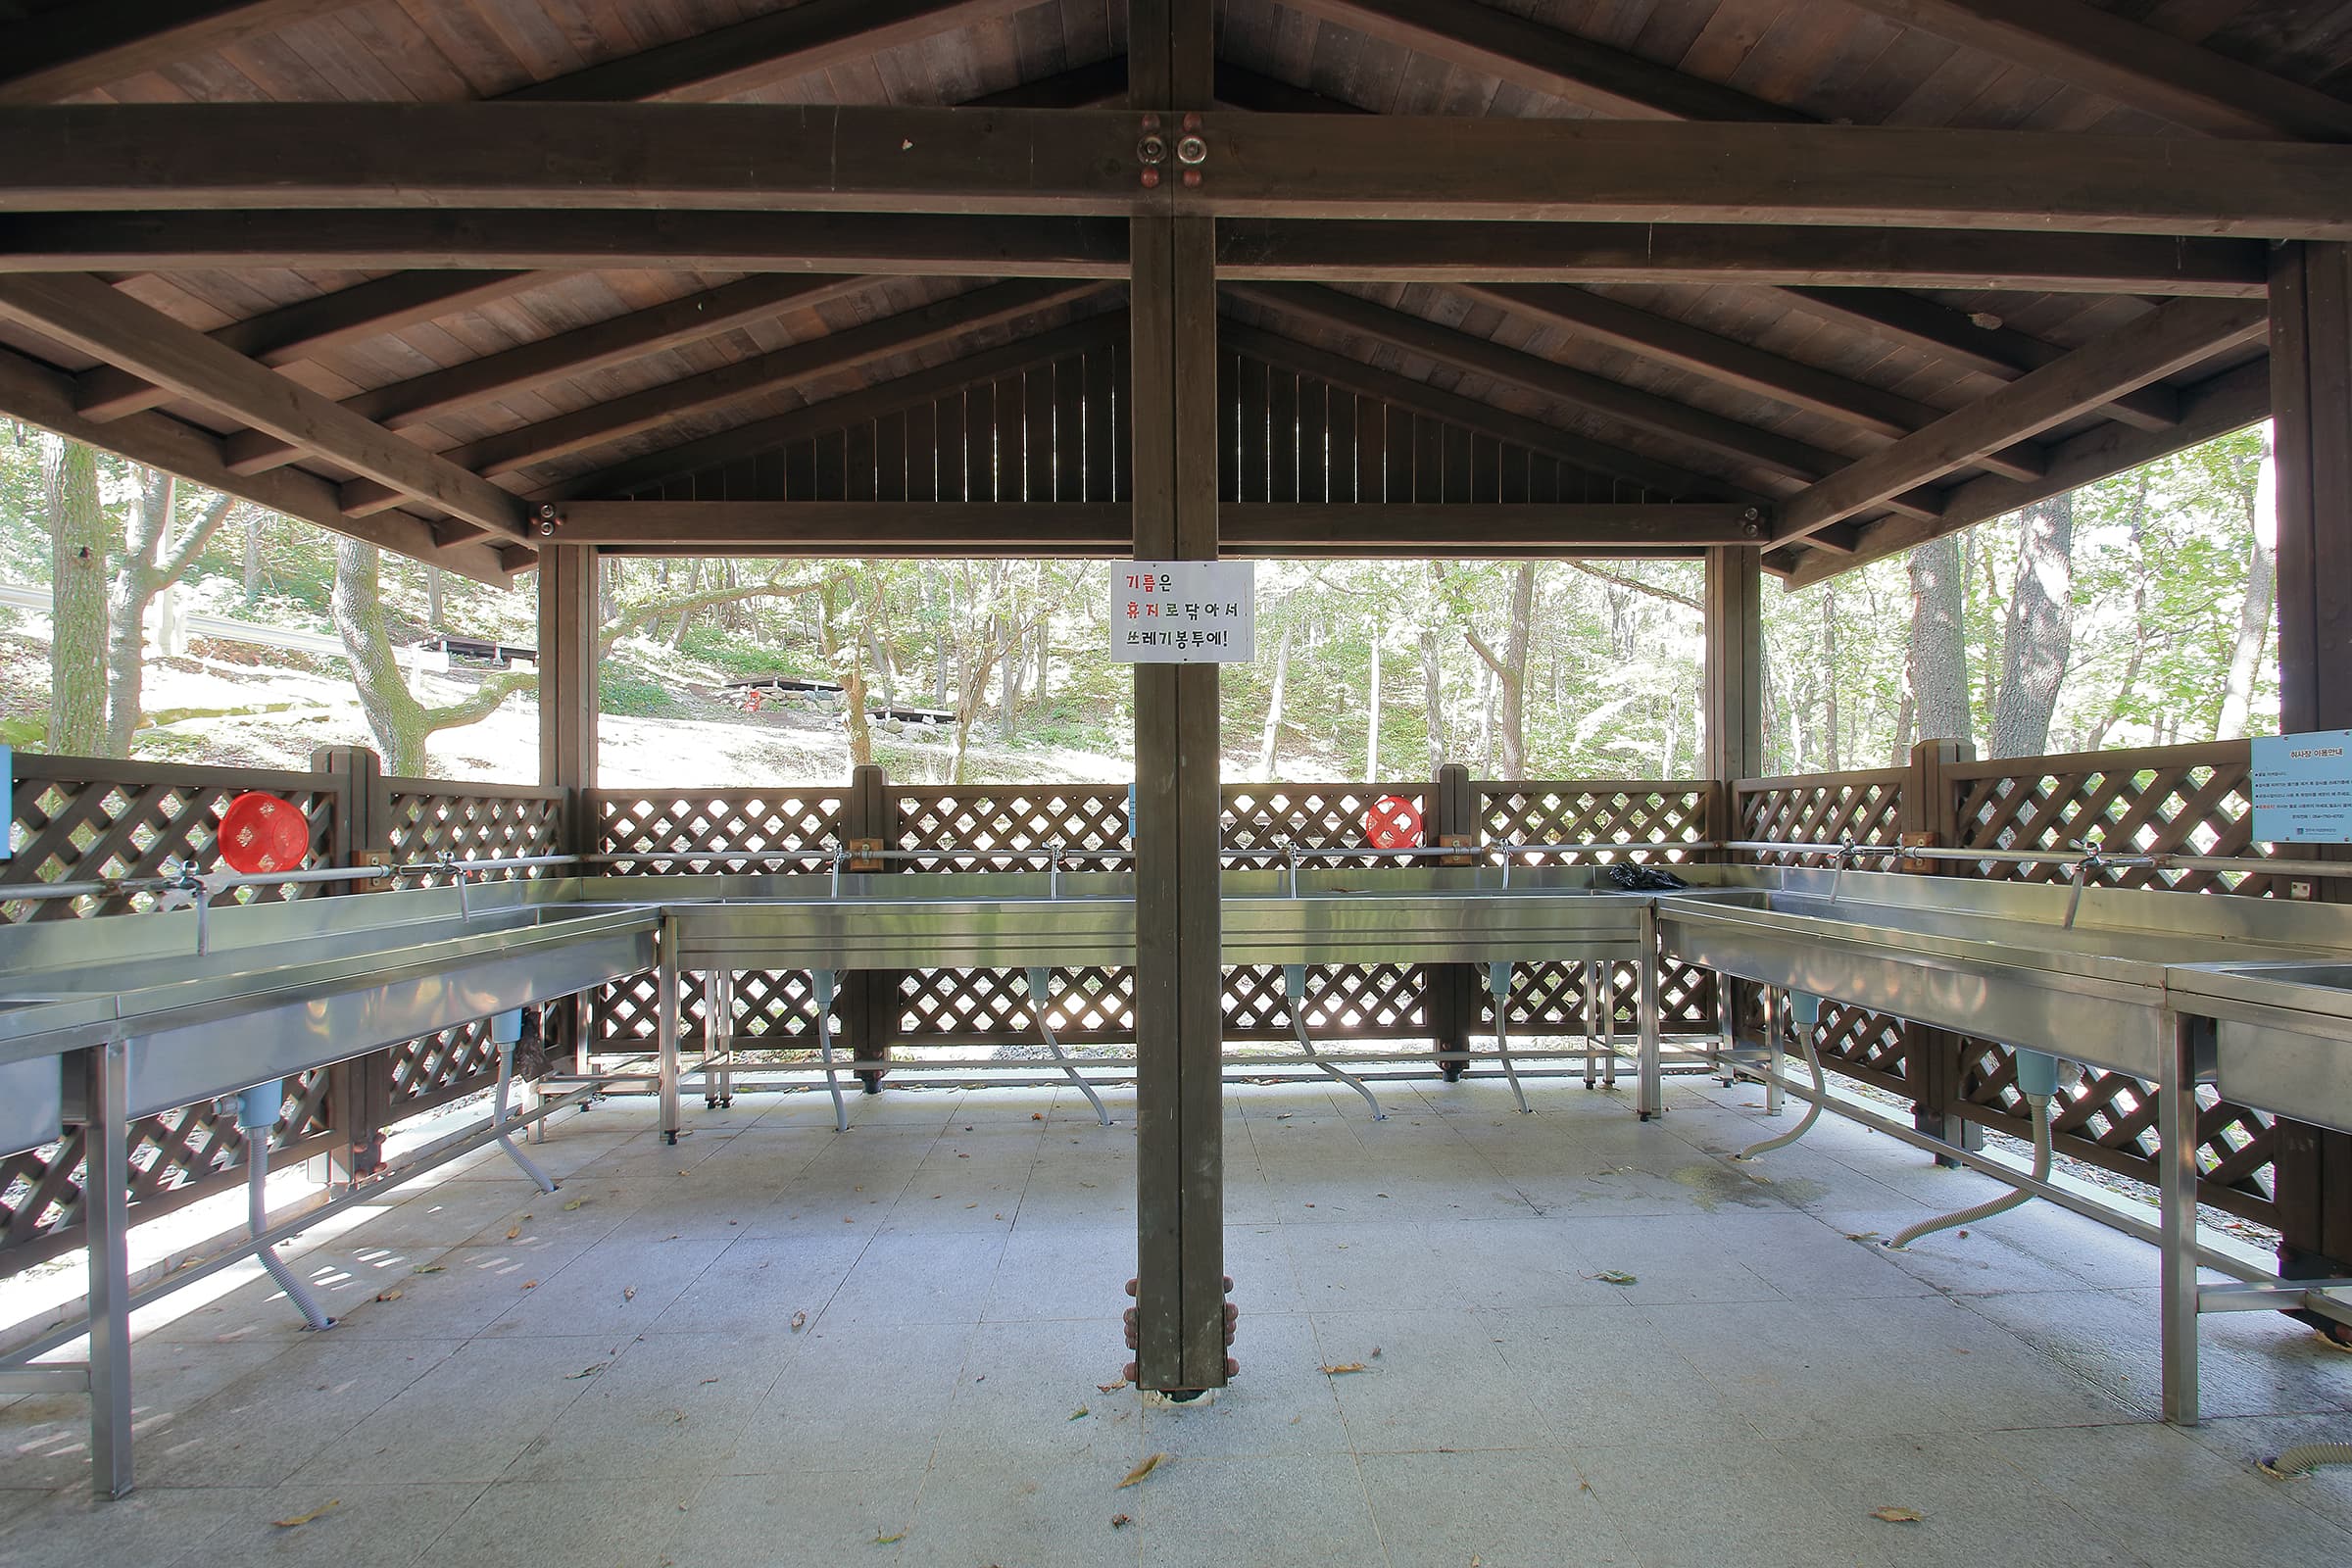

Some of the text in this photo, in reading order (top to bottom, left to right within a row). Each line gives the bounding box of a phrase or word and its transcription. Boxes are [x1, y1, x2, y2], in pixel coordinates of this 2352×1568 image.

[1126, 573, 1172, 593] 기름은
[1126, 630, 1229, 650] 쓰레기봉투에!
[2290, 748, 2343, 759] 취사장 이용안내
